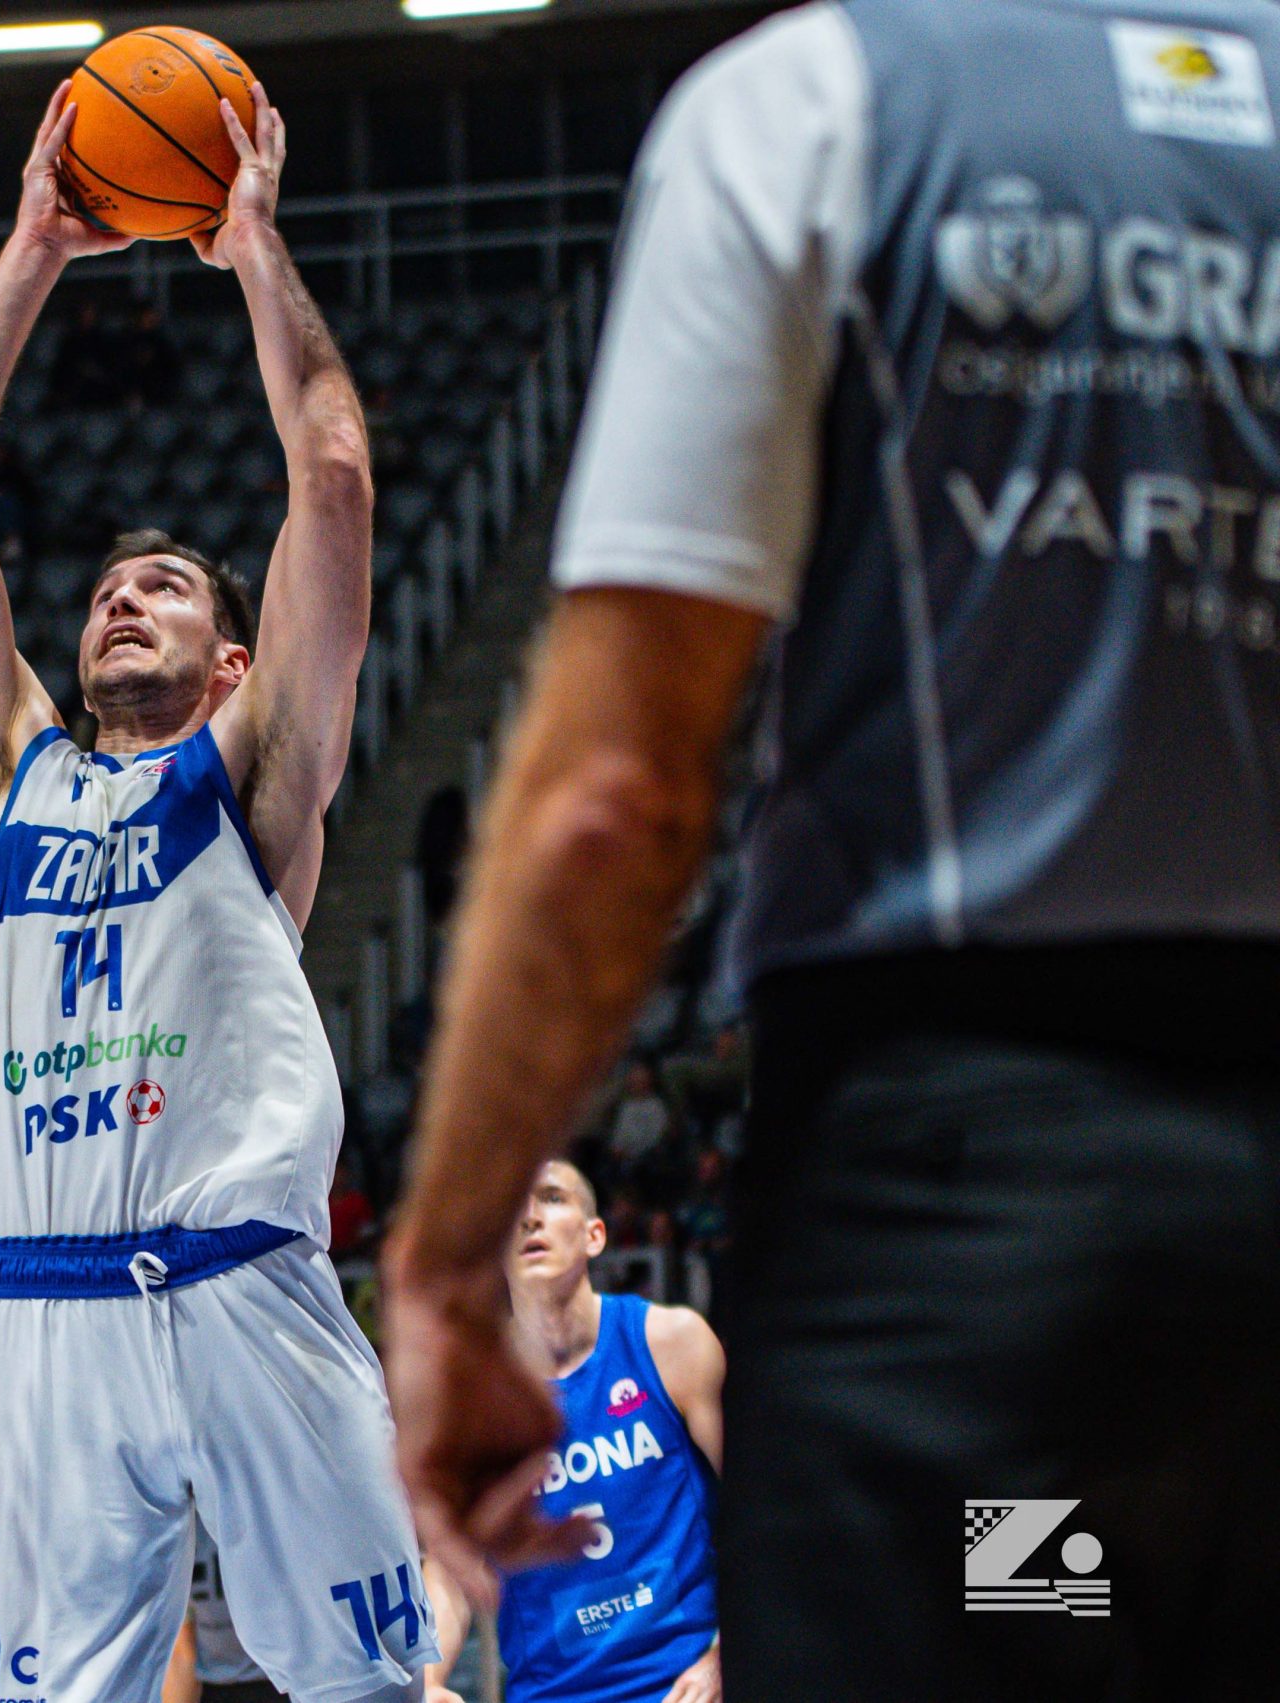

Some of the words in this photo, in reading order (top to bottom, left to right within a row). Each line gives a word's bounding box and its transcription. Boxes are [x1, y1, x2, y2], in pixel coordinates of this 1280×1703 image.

[54, 923, 123, 1019] 14
[24, 1084, 122, 1156] PSK
[531, 1420, 664, 1497] BONA
[330, 1562, 420, 1662] 14
[576, 1593, 635, 1625] ERSTE
[582, 1620, 612, 1636] Bank
